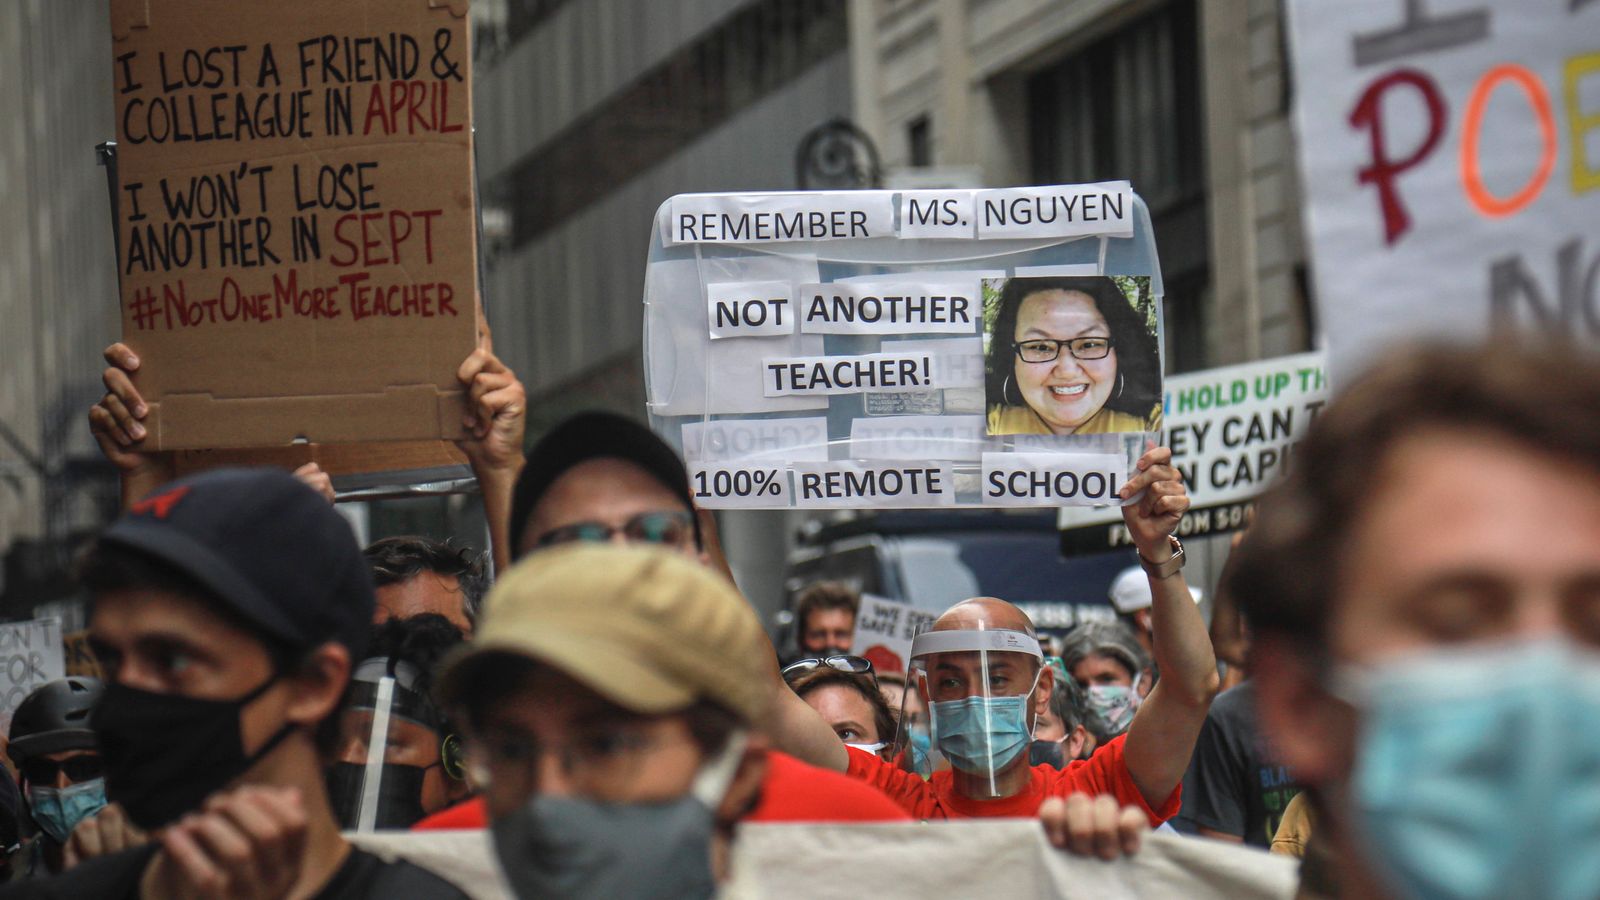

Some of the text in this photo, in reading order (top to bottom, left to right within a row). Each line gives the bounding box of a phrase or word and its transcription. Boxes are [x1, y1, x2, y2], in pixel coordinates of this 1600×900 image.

[117, 28, 463, 94] I LOST A FRIEND &
[123, 80, 464, 144] COLLEAGUE IN APRIL
[124, 162, 381, 221] I WON'T LOSE
[679, 192, 1124, 241] REMEMBER MS. NGUYEN
[125, 209, 443, 275] ANOTHER IN SEPT
[716, 295, 970, 328] NOT ANOTHER
[768, 357, 930, 390] TEACHER!
[1178, 380, 1248, 414] HOLD
[1254, 372, 1291, 401] UP
[1222, 407, 1294, 449] CAN
[694, 468, 1122, 499] 100% REMOTE SCHOOL
